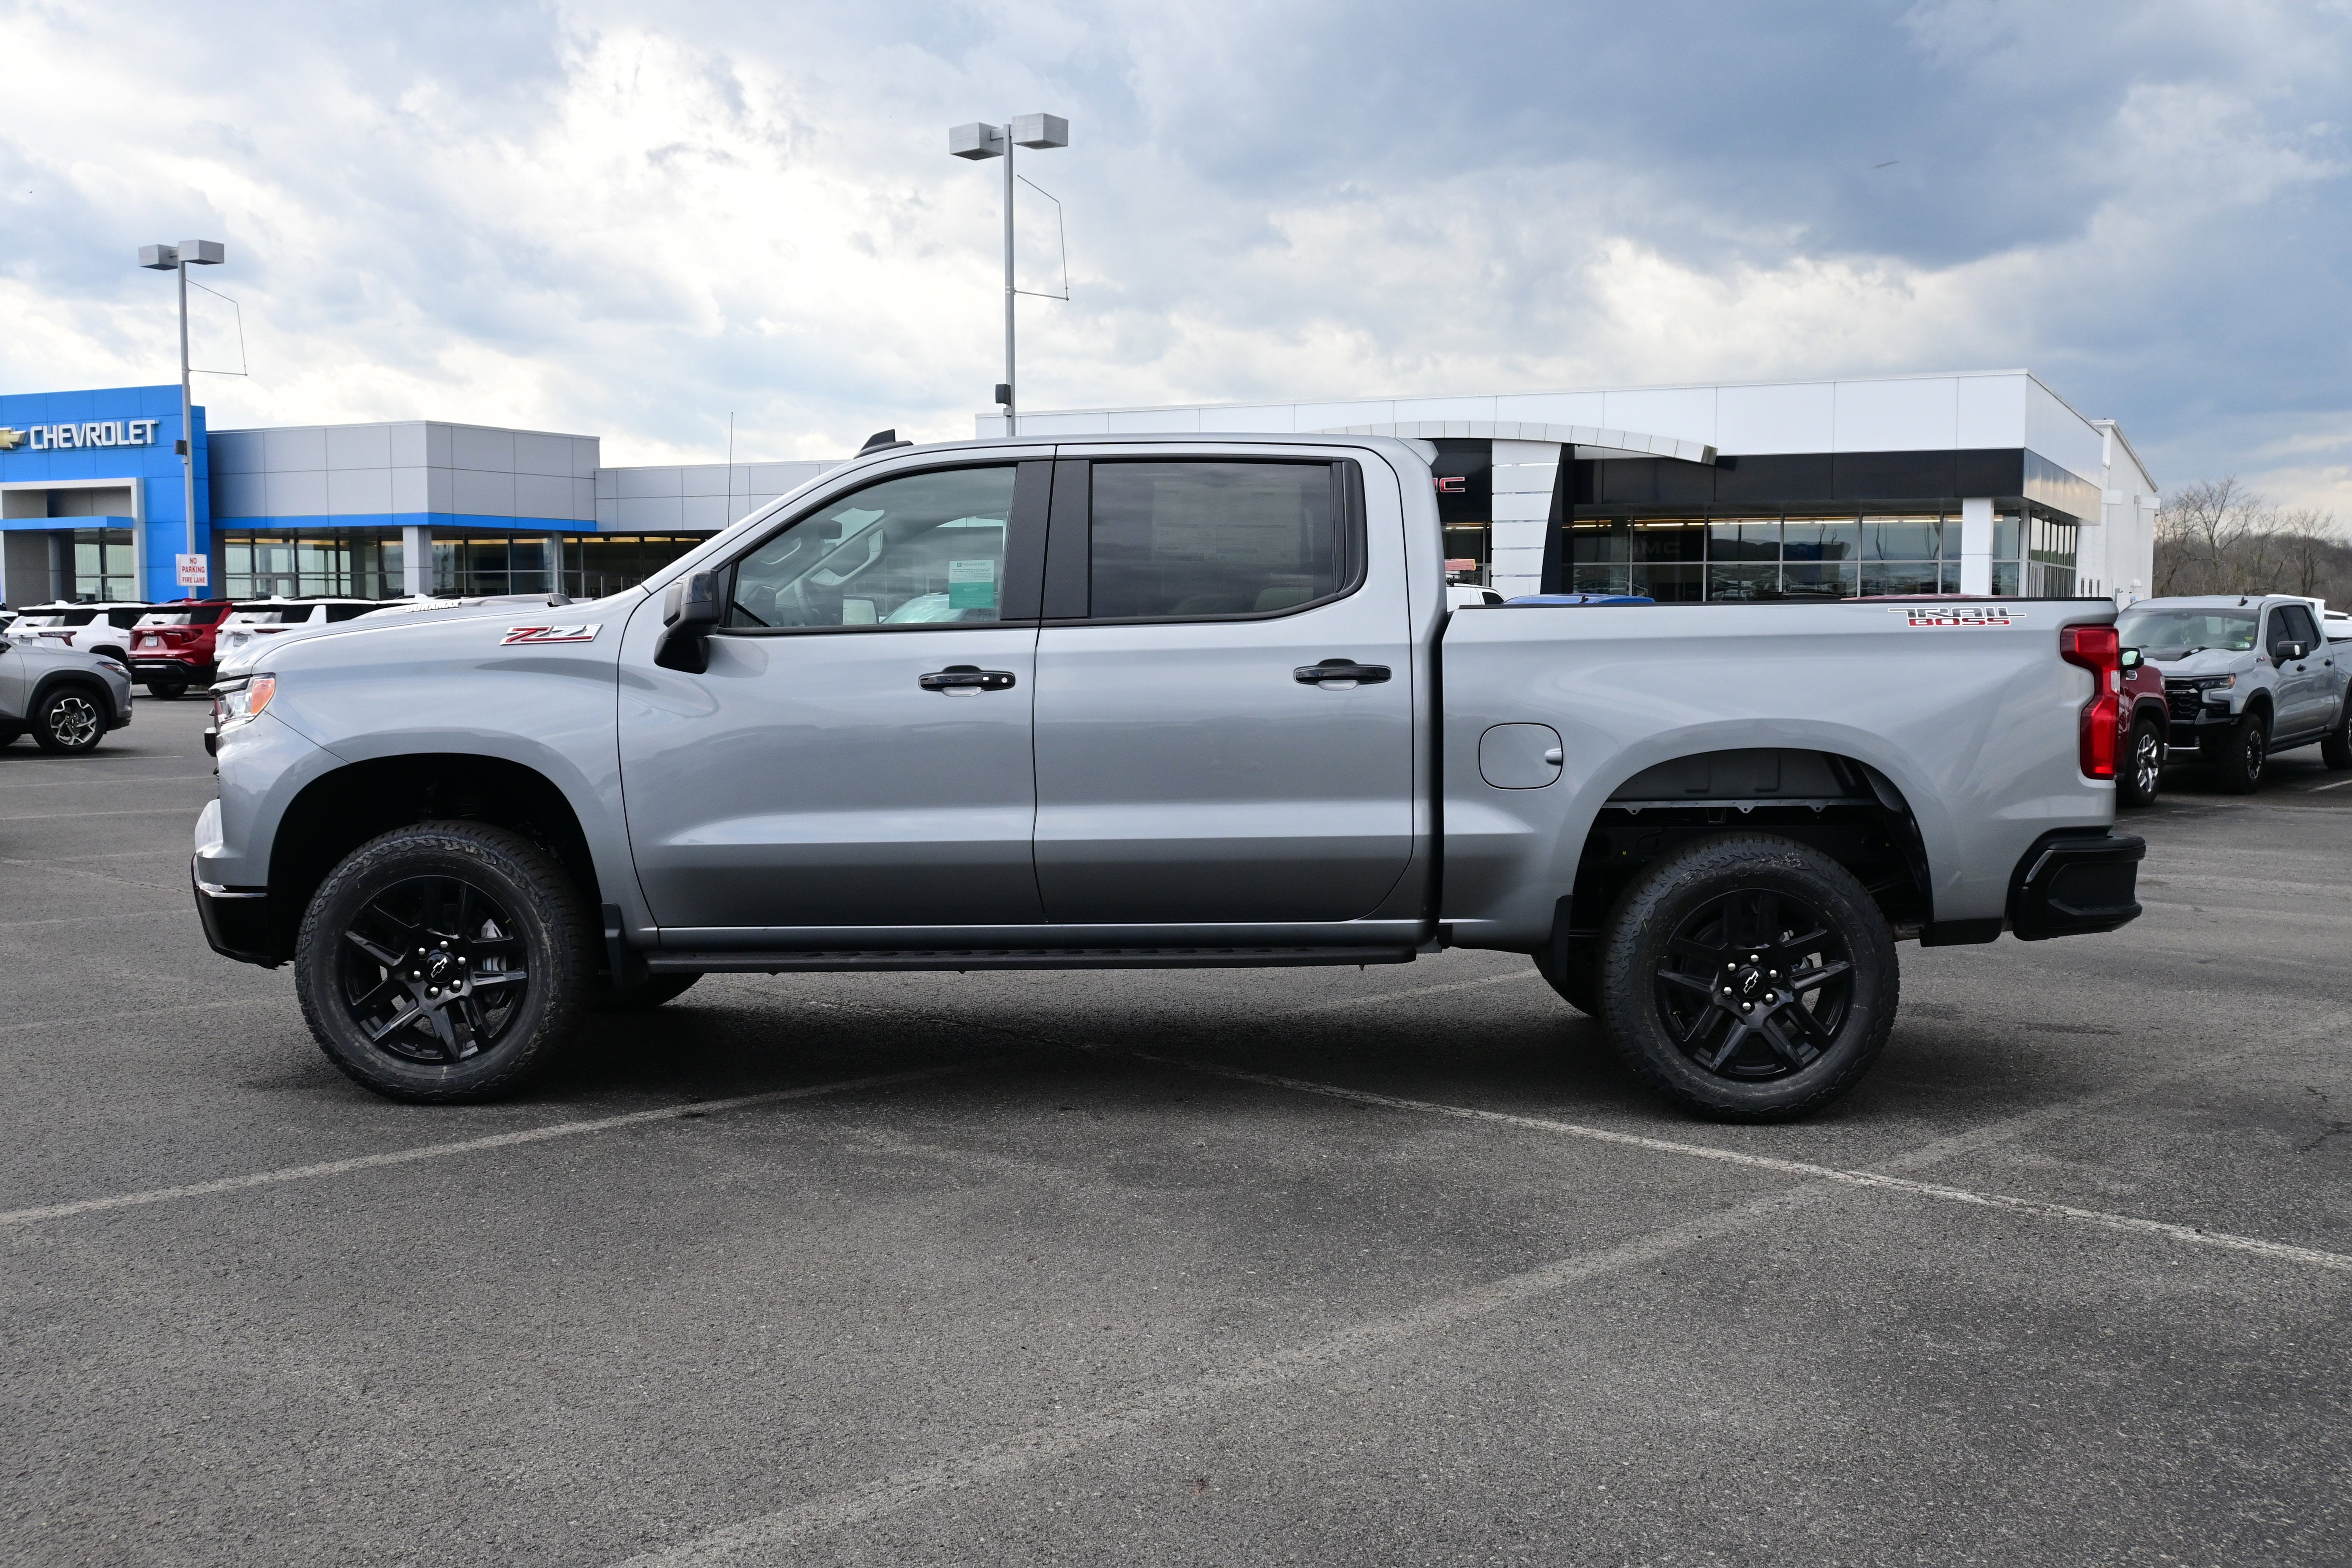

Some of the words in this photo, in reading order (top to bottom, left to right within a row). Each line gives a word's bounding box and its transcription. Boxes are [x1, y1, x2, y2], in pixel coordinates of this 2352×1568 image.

[30, 419, 158, 449] CHEVROLET
[405, 601, 460, 613] DURAMAX
[1888, 607, 2026, 618] TRAIL
[1908, 617, 2011, 627] BOSS
[499, 624, 603, 645] Z71
